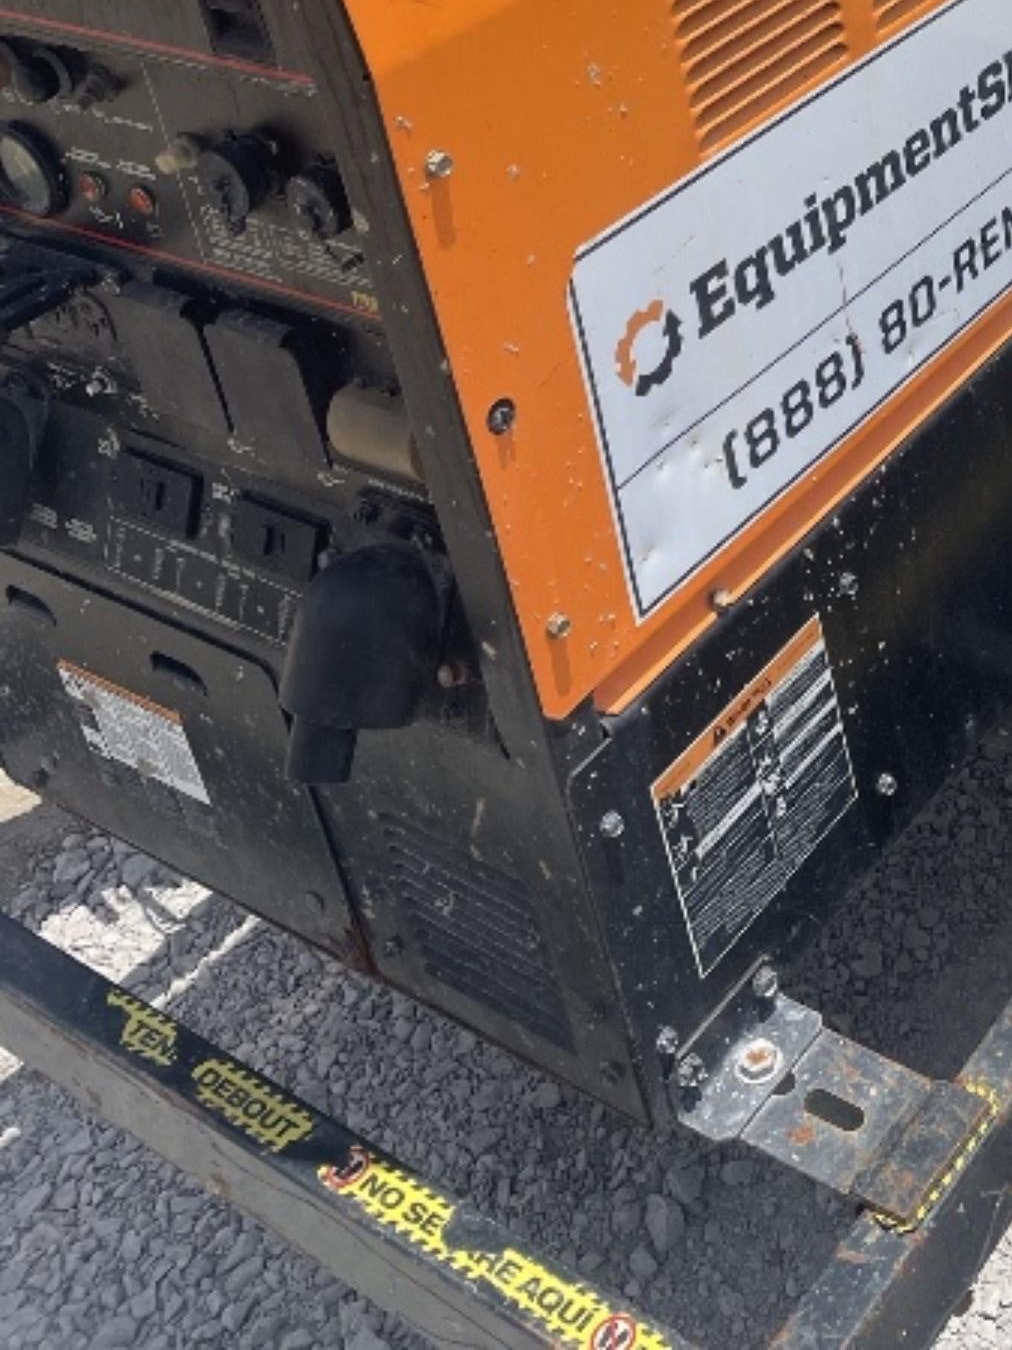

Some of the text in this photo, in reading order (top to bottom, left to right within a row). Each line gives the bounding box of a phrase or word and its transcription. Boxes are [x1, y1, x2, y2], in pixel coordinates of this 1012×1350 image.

[722, 334, 866, 490] (888)
[200, 1067, 299, 1139] DEBOUT
[360, 1175, 404, 1213] NO
[404, 1201, 446, 1238] SE
[518, 1276, 600, 1333] AQUÍ
